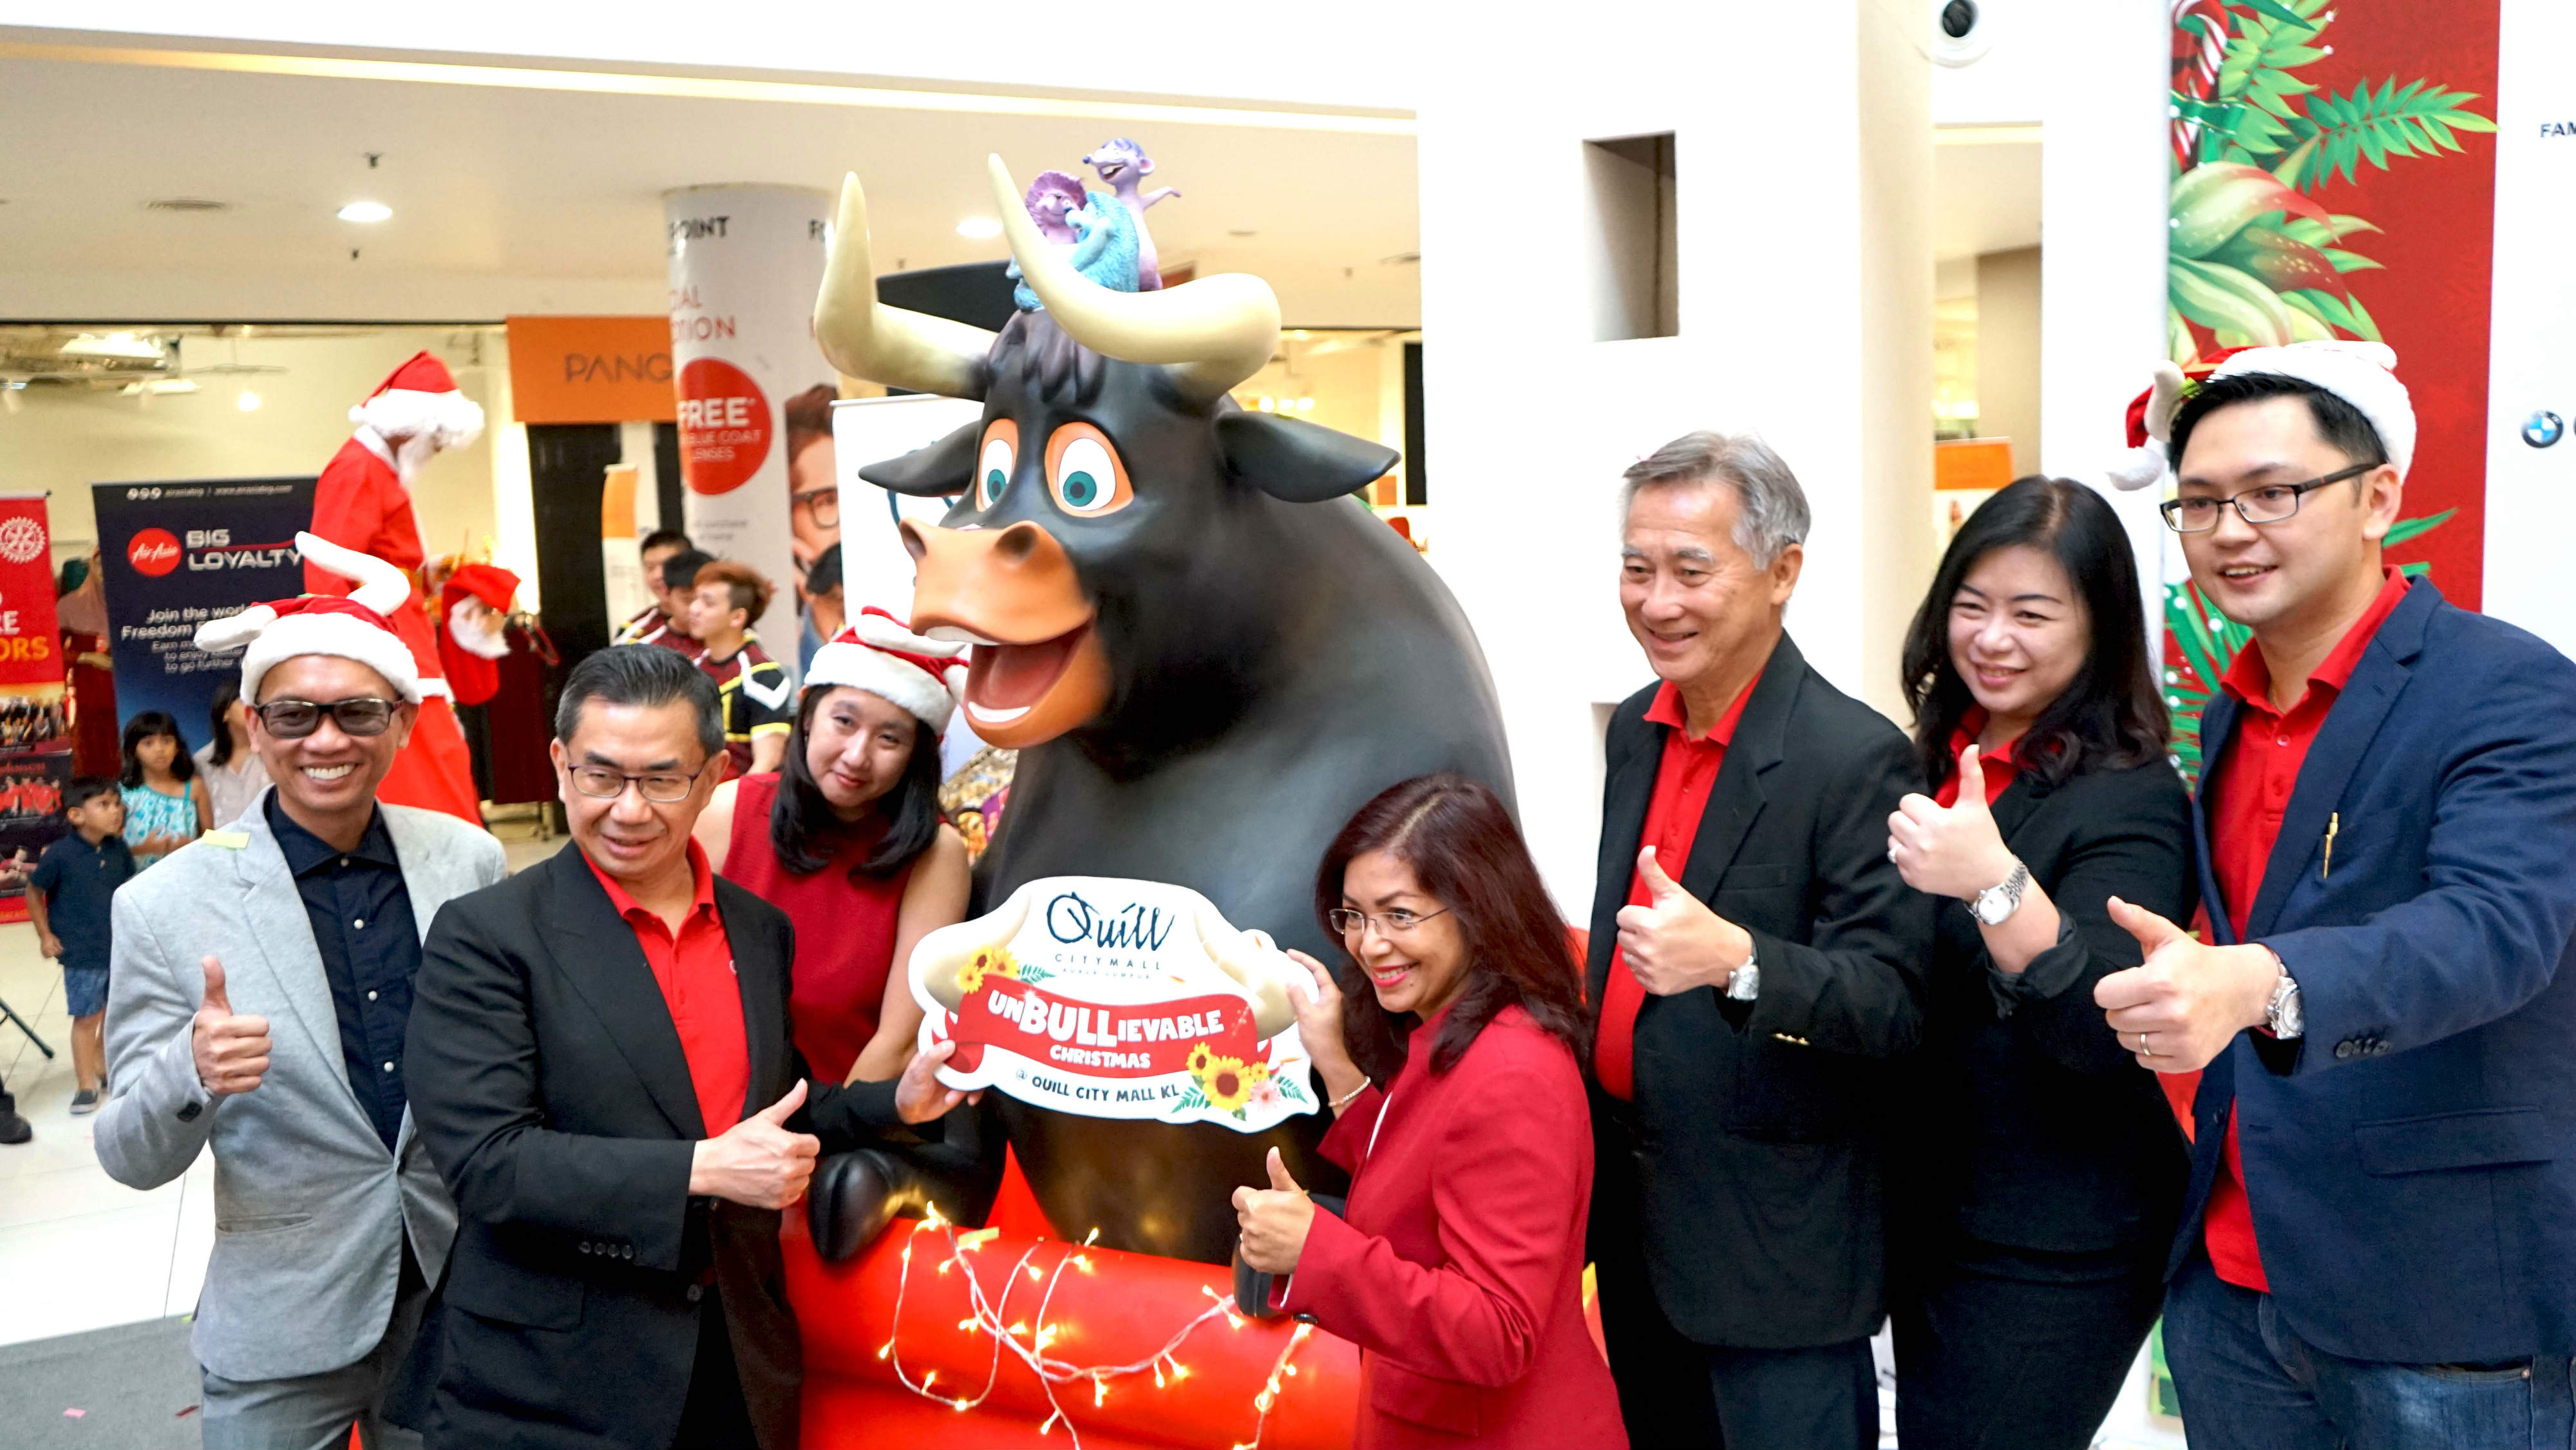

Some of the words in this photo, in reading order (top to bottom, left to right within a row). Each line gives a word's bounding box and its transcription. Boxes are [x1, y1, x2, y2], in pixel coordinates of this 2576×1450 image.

[565, 353, 672, 383] PANG
[186, 528, 230, 549] BIG
[188, 548, 301, 571] LOYALTY
[146, 609, 180, 624] Join
[183, 606, 208, 620] the
[121, 624, 193, 641] Freedom
[151, 640, 178, 653] Earn
[164, 651, 178, 663] to
[165, 662, 178, 673] to
[1046, 892, 1175, 951] Quill
[1049, 1044, 1151, 1069] CHRISTMAS
[1032, 1075, 1070, 1097] QUILL
[1076, 1086, 1110, 1102] CITY
[1115, 1087, 1156, 1102] MALL
[1160, 1083, 1180, 1100] KL
